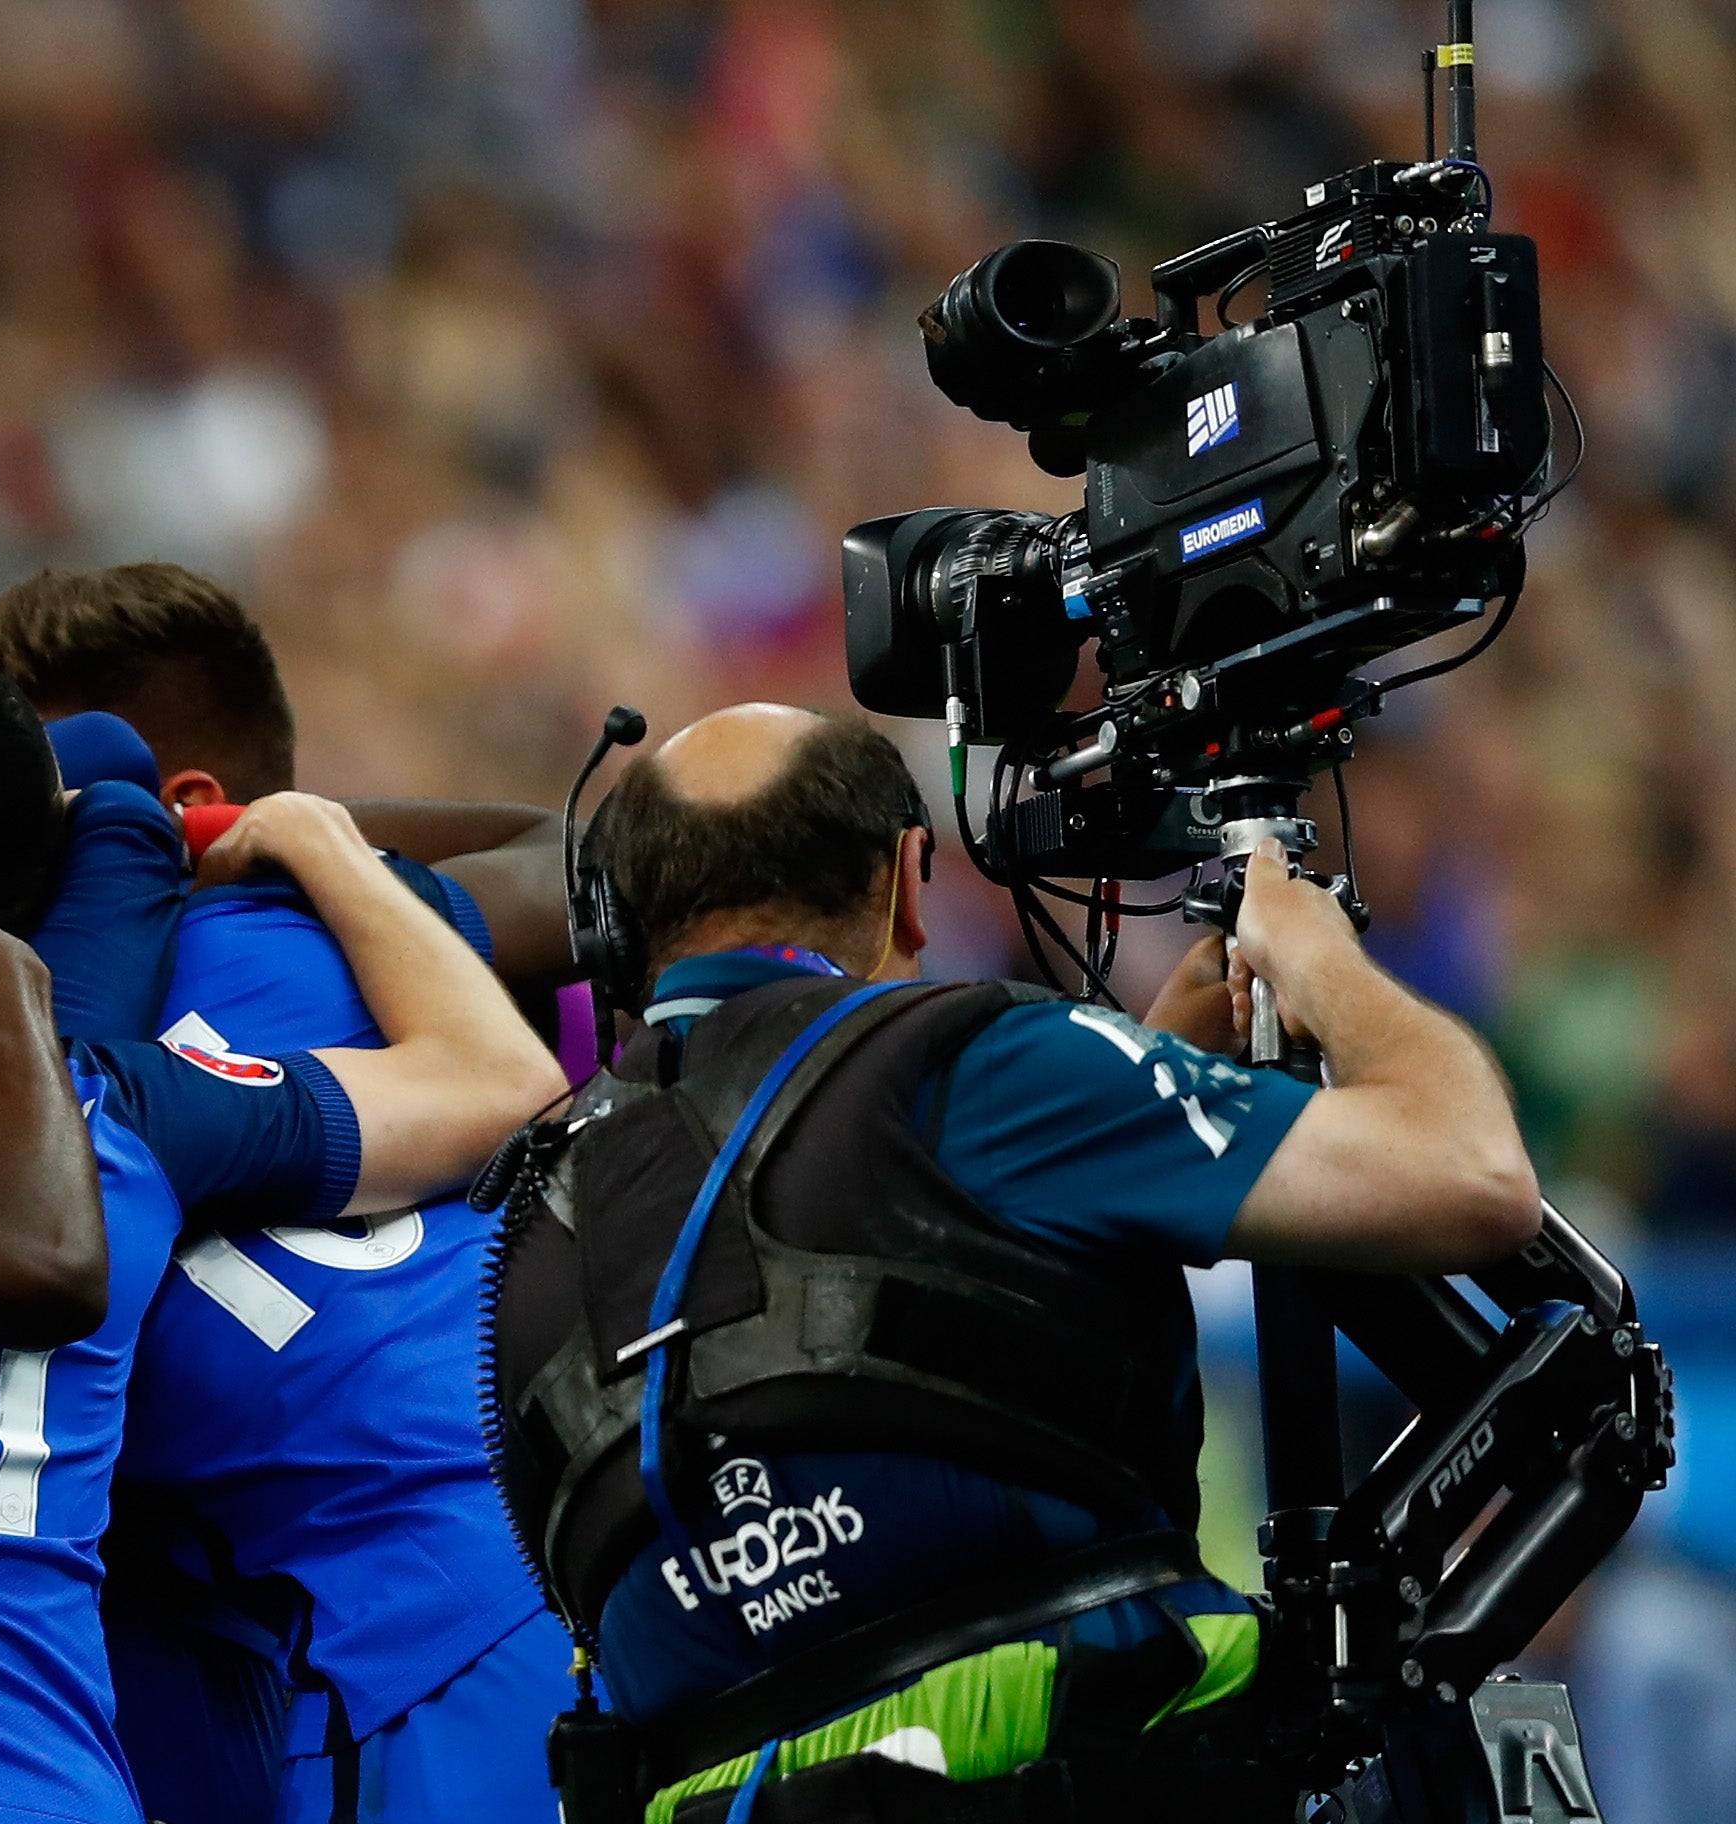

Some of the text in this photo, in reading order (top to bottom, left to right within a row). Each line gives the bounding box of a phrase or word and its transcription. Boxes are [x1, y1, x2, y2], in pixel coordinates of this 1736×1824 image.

[1183, 507, 1262, 554] EUROMEDIA
[714, 1466, 772, 1504] EFA
[1429, 1420, 1495, 1509] PRO
[741, 1570, 841, 1636] RANCE
